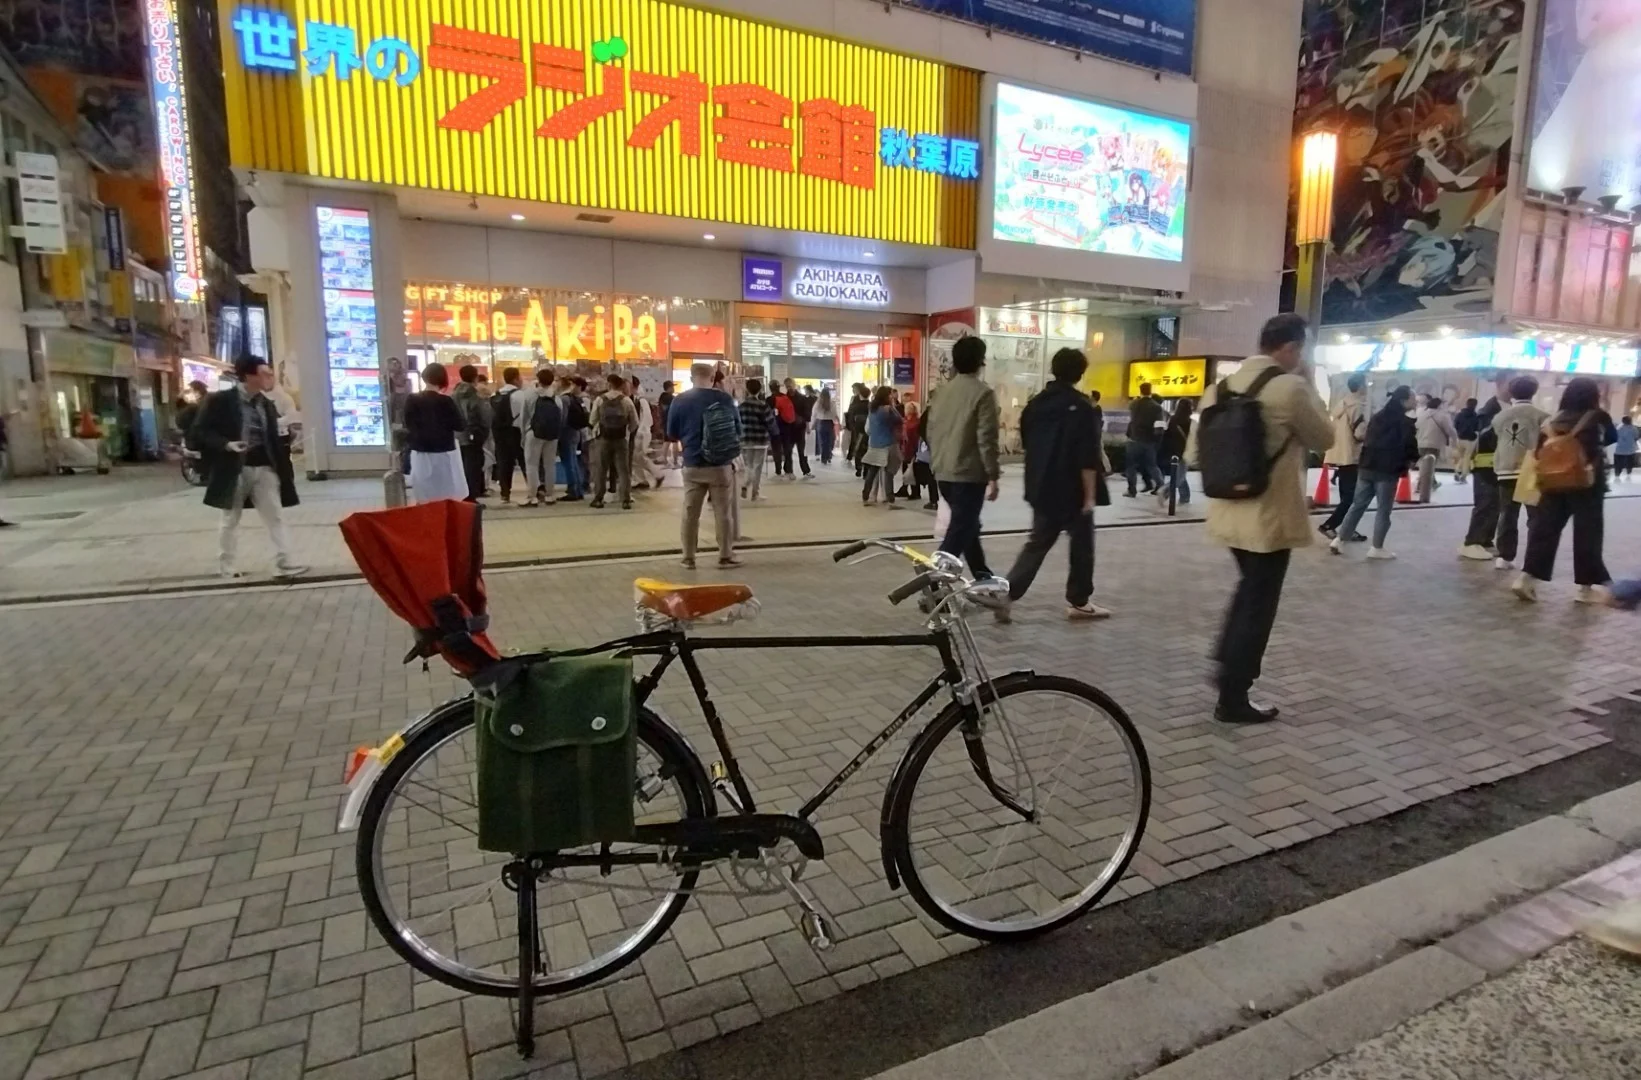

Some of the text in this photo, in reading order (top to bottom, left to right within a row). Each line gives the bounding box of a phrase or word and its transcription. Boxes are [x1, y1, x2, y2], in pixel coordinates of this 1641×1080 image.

[232, 7, 421, 88] 世界の
[427, 22, 876, 190] ラジオ会館
[879, 126, 981, 180] 秋葉原
[802, 268, 883, 286] AKIHABARA
[453, 287, 502, 305] SHOP
[795, 283, 888, 302] RADIOKAIKAN
[443, 303, 508, 344] The
